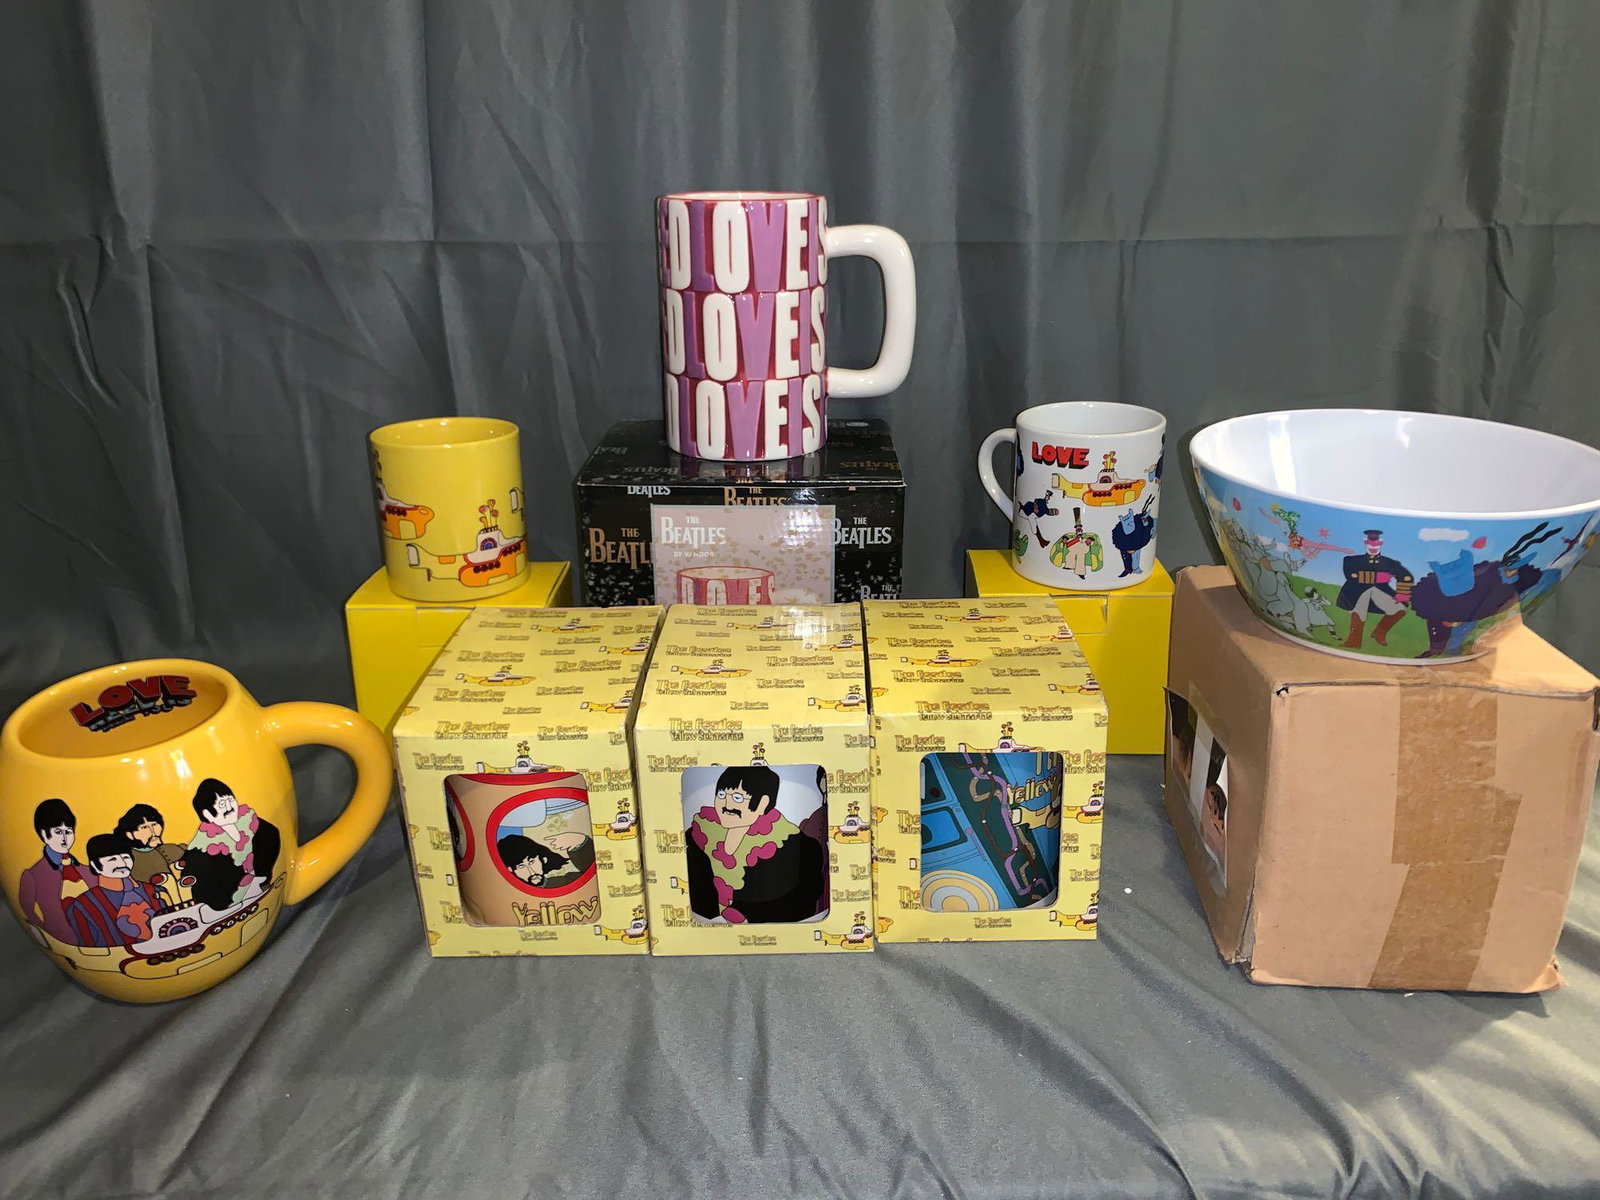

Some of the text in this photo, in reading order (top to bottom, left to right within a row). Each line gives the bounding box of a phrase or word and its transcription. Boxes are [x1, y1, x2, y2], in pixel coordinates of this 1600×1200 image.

[1032, 441, 1090, 469] LOVE
[621, 528, 639, 537] THE
[661, 516, 727, 549] BEATLES
[686, 516, 699, 524] THE
[833, 518, 892, 549] BEATLES
[853, 517, 867, 525] THE
[589, 528, 651, 570] BEATL
[69, 675, 198, 727] LOVE
[512, 896, 598, 926] Yellow
